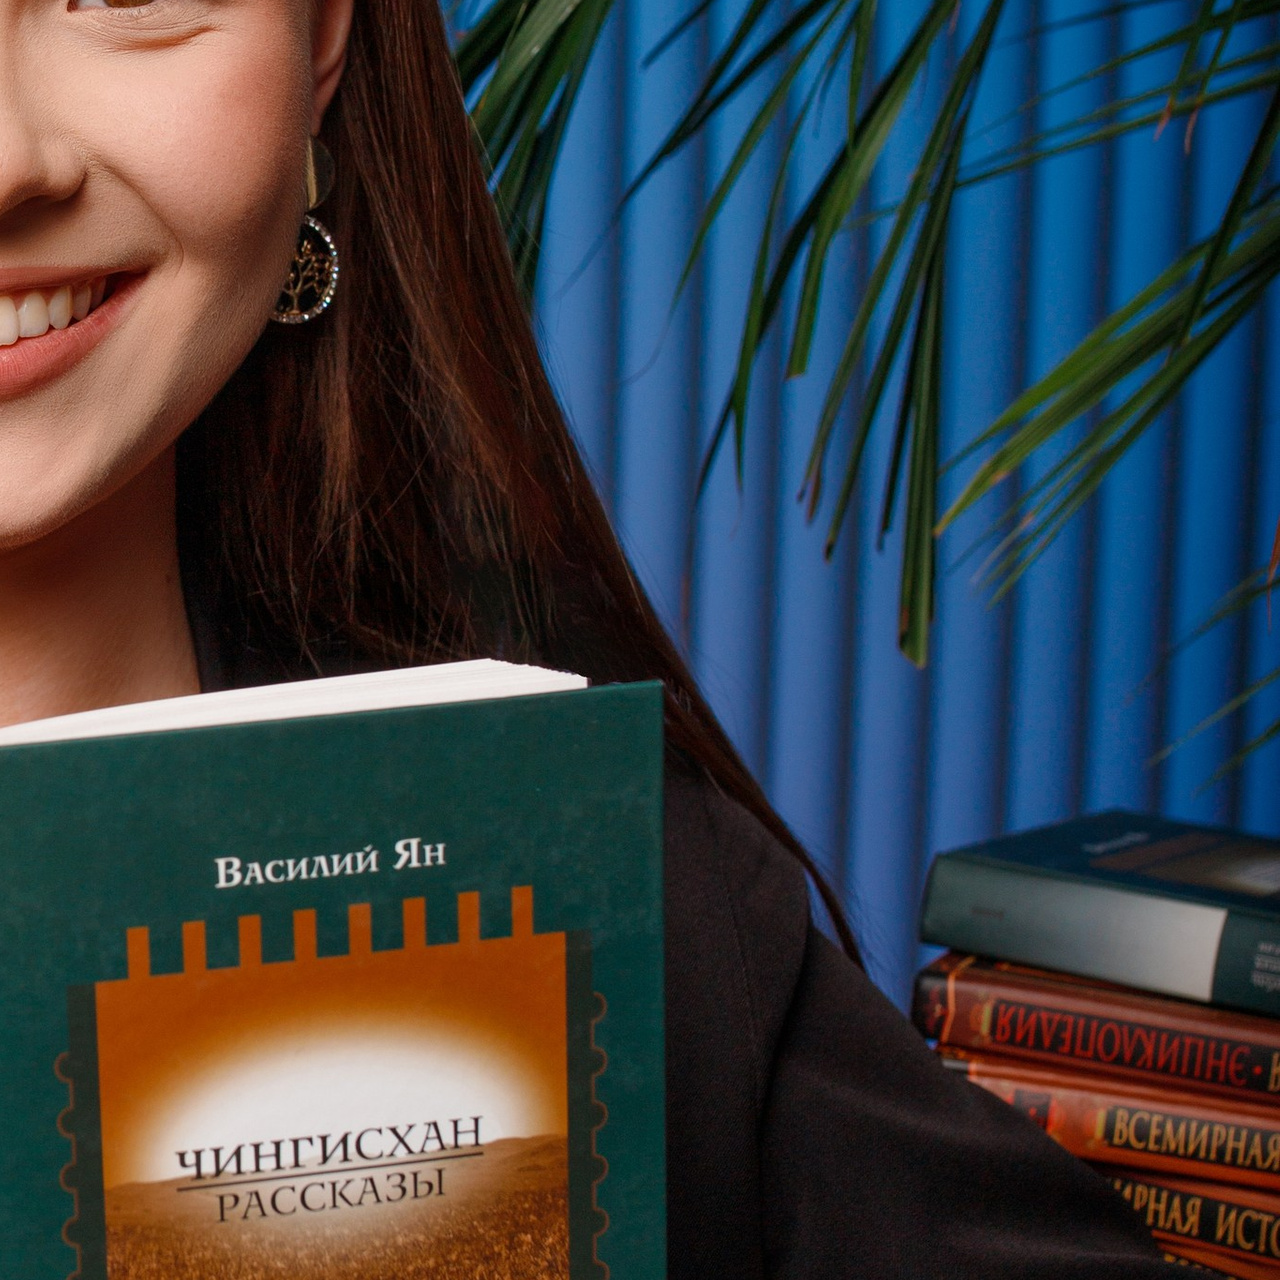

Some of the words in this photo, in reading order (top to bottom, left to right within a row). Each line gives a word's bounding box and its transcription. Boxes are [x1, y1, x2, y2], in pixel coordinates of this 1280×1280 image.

[994, 1003, 1252, 1087] ЭНЦИКЛОПЕДИЯ
[175, 1116, 484, 1180] ЧИНГИСХАН
[1113, 1108, 1280, 1171] ВСЕМИРНАЯ
[215, 1168, 446, 1222] РАССКАЗЫ
